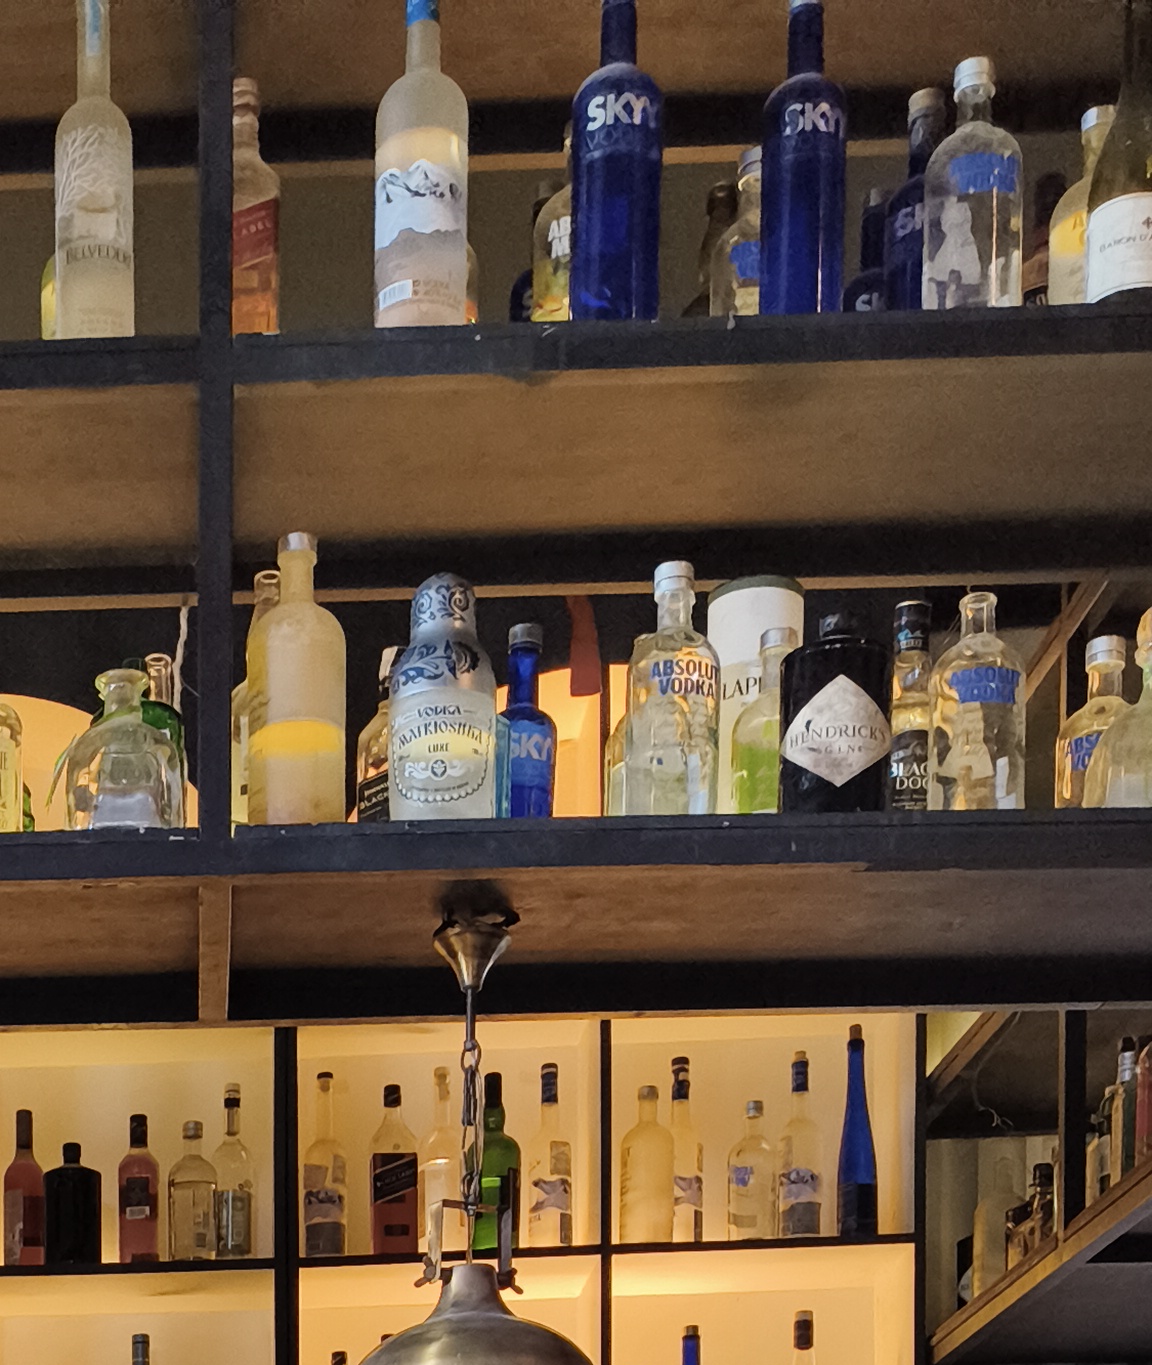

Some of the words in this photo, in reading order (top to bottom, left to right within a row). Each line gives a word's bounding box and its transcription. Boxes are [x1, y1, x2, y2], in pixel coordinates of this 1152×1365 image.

[651, 656, 719, 686] ABSOLUT
[658, 677, 715, 701] VODKA
[417, 705, 462, 718] VODKA
[789, 723, 887, 751] HENDRICK'S
